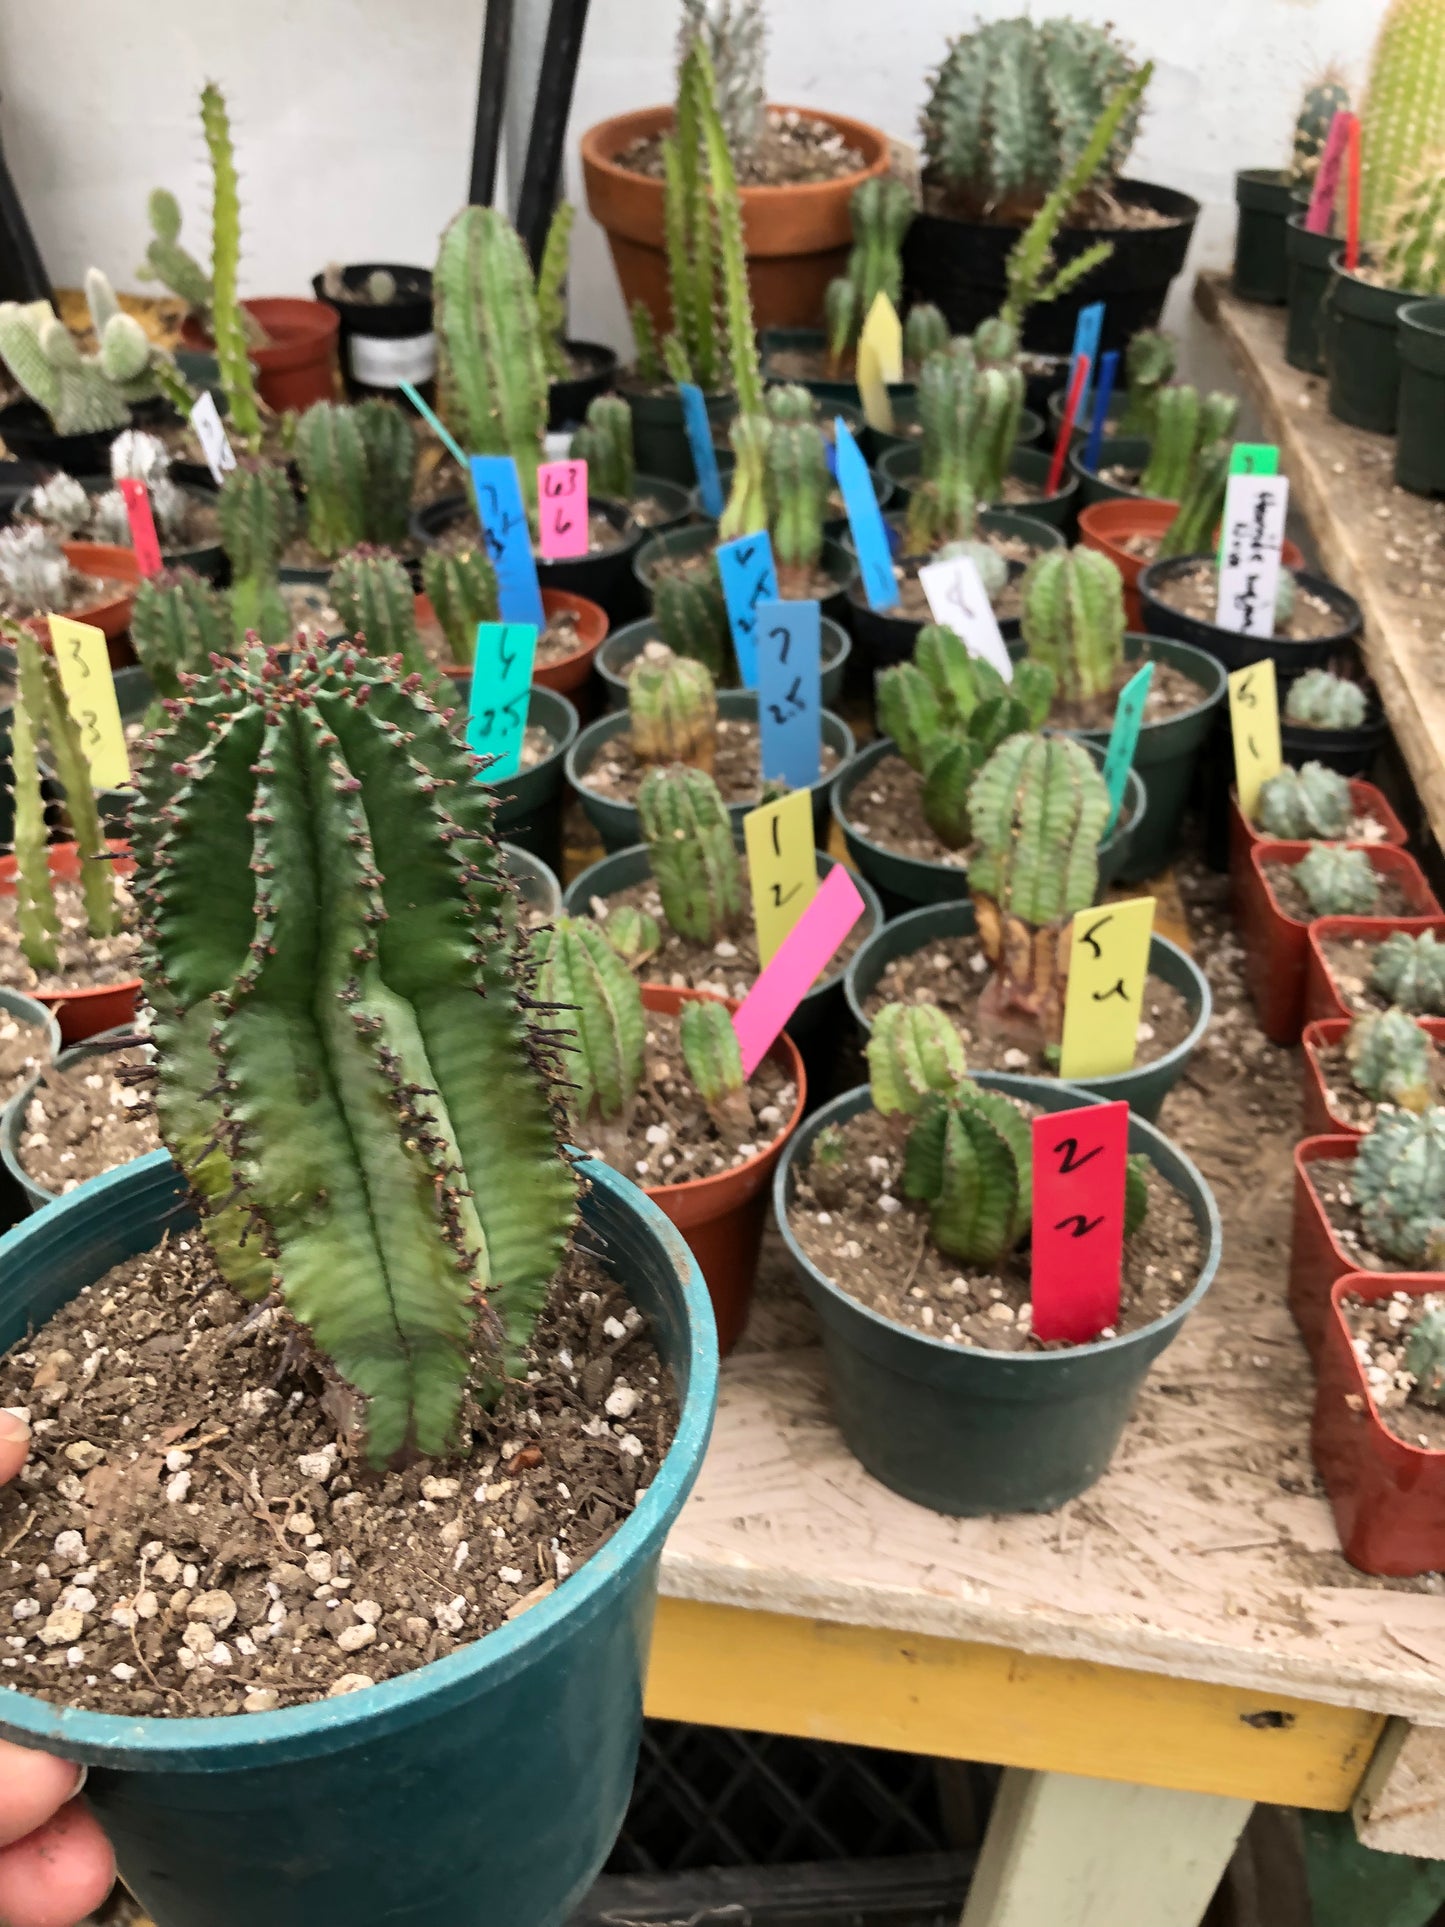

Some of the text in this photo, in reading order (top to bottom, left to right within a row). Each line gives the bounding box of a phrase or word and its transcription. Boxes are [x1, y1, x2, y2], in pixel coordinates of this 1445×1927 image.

[69, 637, 91, 678] 3
[81, 709, 102, 744] 3
[1053, 1137, 1105, 1175] 2
[1053, 1214, 1105, 1238] 2
